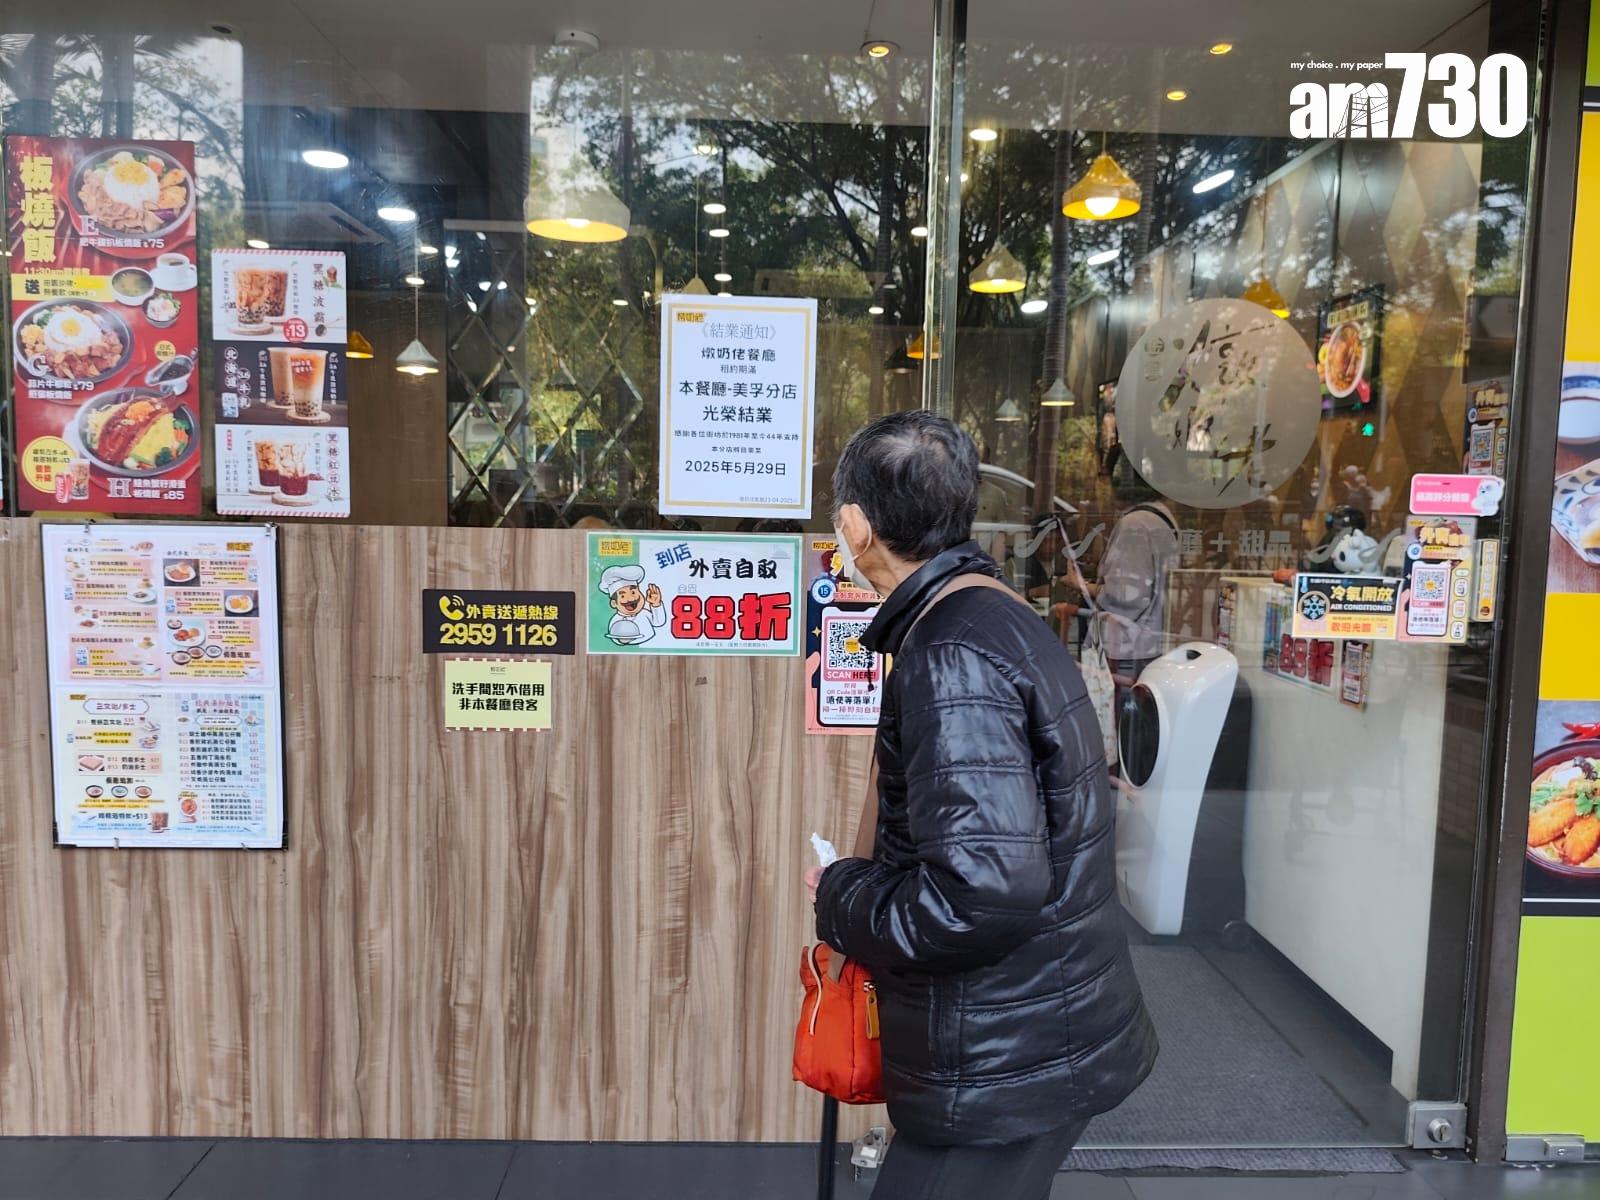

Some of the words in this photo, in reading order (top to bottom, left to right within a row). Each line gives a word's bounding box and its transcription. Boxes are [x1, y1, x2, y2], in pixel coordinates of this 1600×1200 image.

[20, 155, 57, 263] 板燒飯
[80, 215, 99, 236] E
[701, 347, 776, 362] 燉奶佬餐廳
[28, 355, 50, 377] G
[720, 364, 757, 375] 租約期滿
[679, 380, 797, 400] 本餐廳-美孚分店
[703, 405, 773, 423] 光榮結業
[685, 460, 786, 476] 2025年5月29日
[107, 478, 132, 498] H
[655, 543, 692, 569] 到店
[689, 557, 778, 580] 外賣自取
[1330, 585, 1394, 602] 冷氣開放
[466, 604, 559, 620] 外賣送遞熱線
[671, 592, 791, 640] 88折
[1343, 603, 1392, 611] CONDITIONED
[440, 623, 497, 645] 2959
[502, 623, 558, 646] 1126
[452, 682, 545, 696] 洗手間恕不借用
[459, 698, 538, 711] 非本餐廳食客
